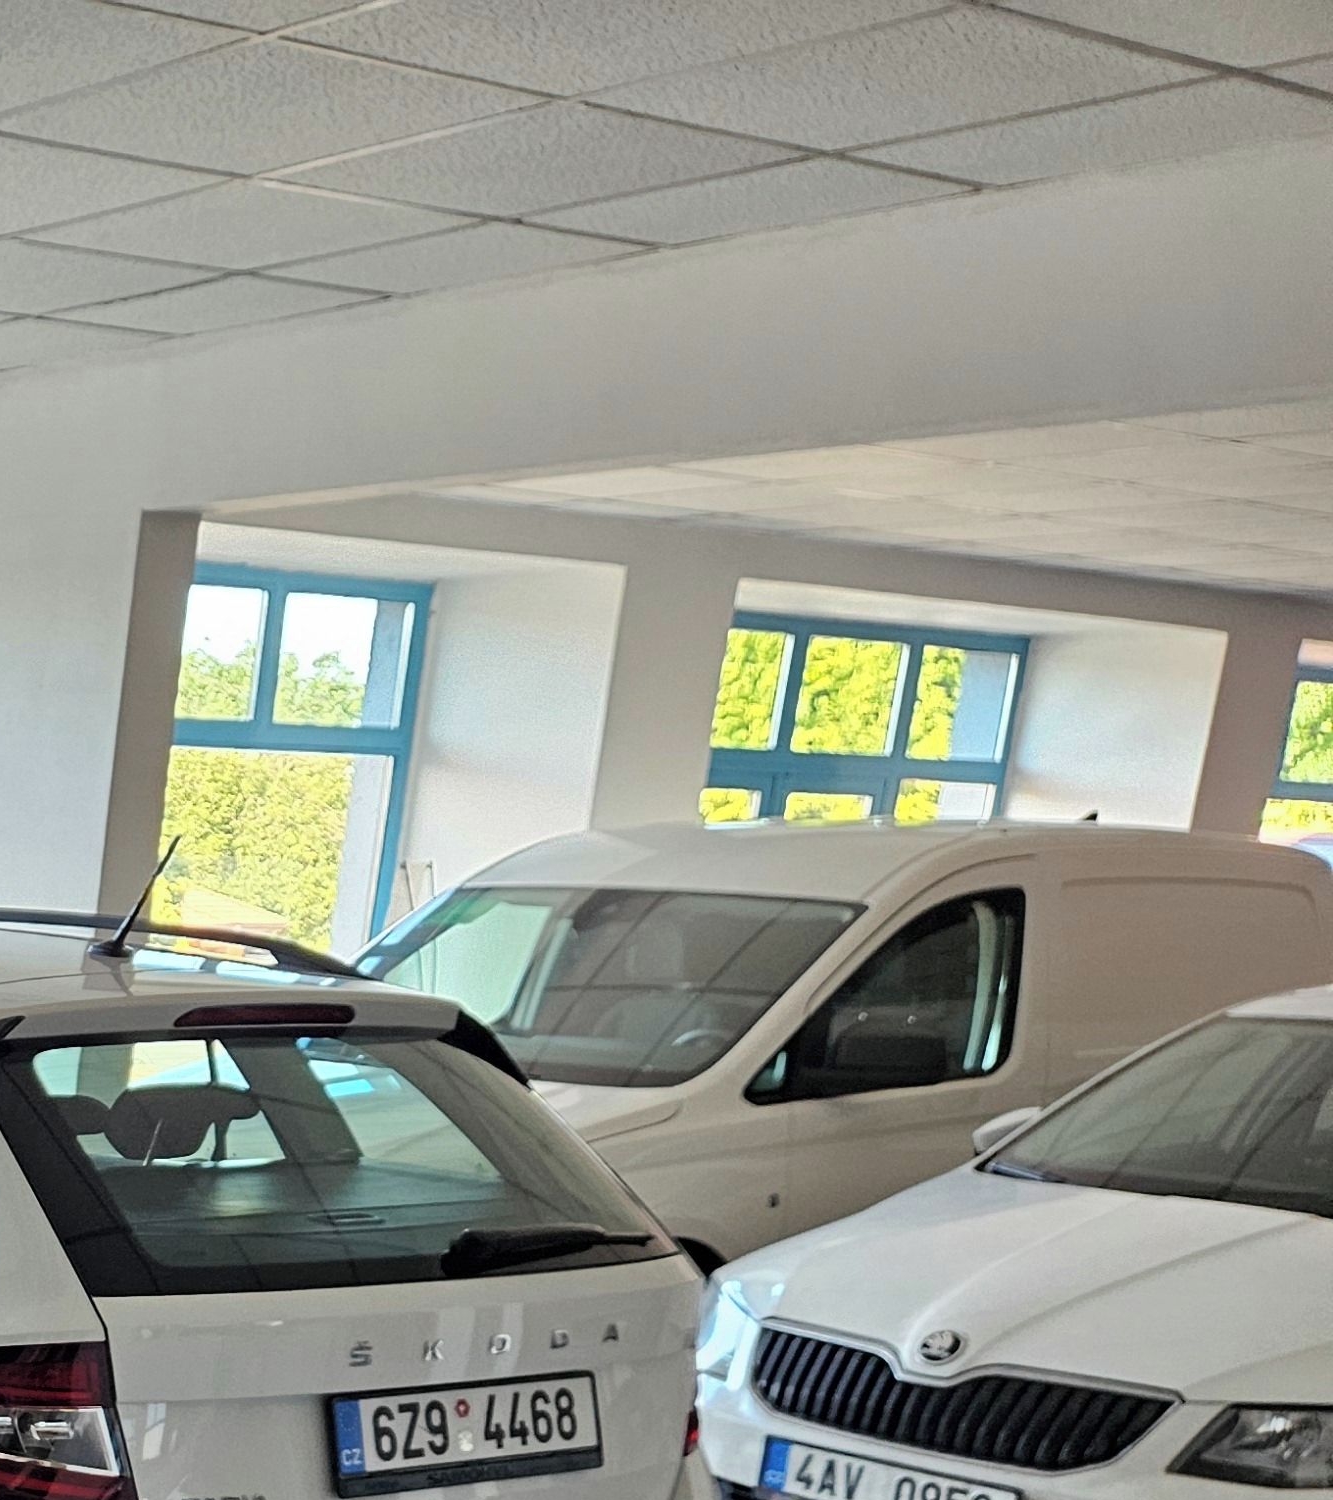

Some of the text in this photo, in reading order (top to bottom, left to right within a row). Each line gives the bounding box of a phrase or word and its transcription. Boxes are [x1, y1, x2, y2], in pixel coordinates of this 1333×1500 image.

[373, 1387, 578, 1462] 6Z9 4468
[341, 1448, 363, 1466] CZ
[795, 1453, 865, 1500] 4AV
